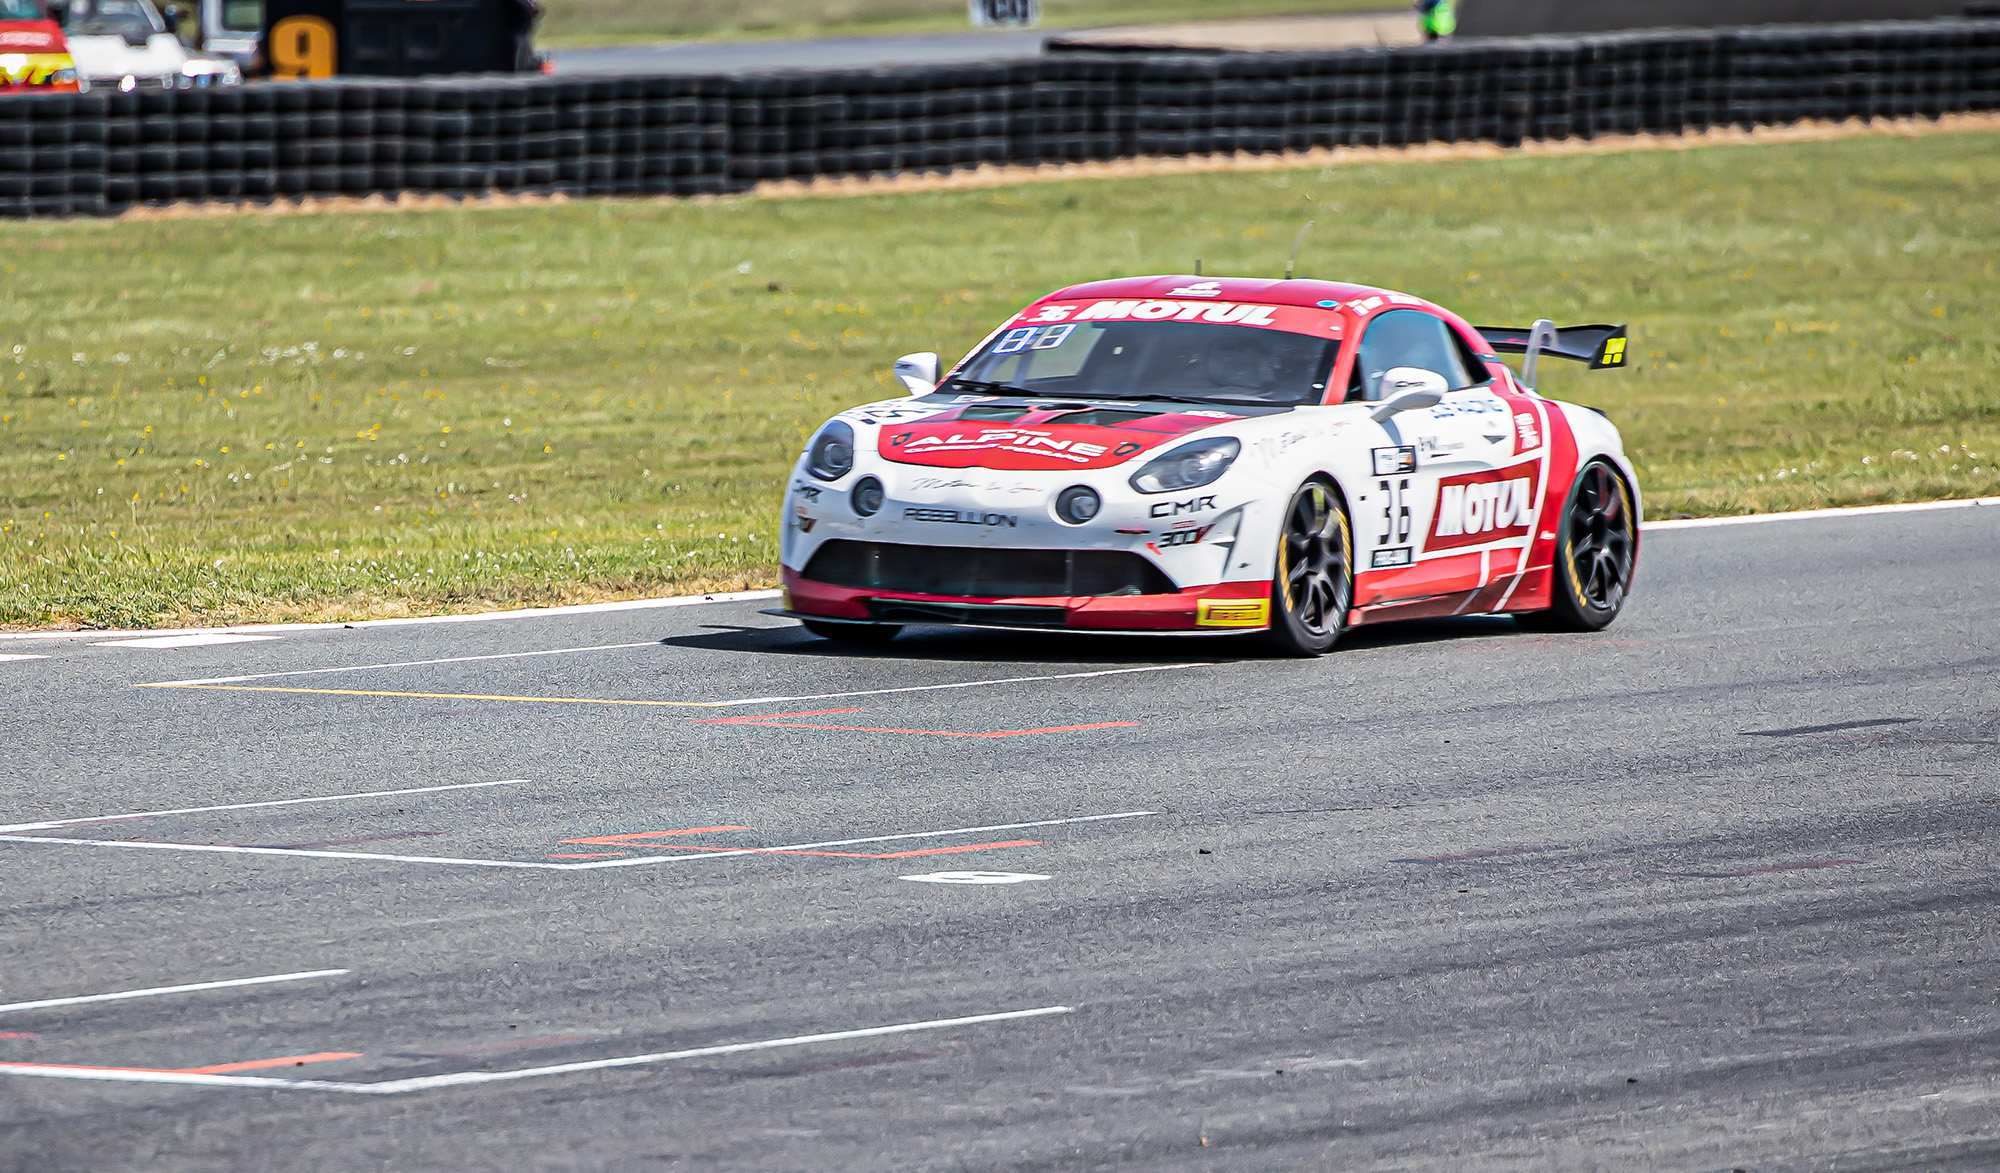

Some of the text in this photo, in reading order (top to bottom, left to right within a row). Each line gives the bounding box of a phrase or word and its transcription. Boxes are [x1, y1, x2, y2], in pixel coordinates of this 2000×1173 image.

[1028, 301, 1278, 325] 36 MOTUL
[904, 433, 1109, 457] ALPINE
[903, 507, 1018, 528] REBELLION
[1148, 494, 1218, 519] CMR
[1378, 478, 1410, 545] 36
[1435, 477, 1534, 537] MOTUL
[1157, 523, 1216, 548] 300V
